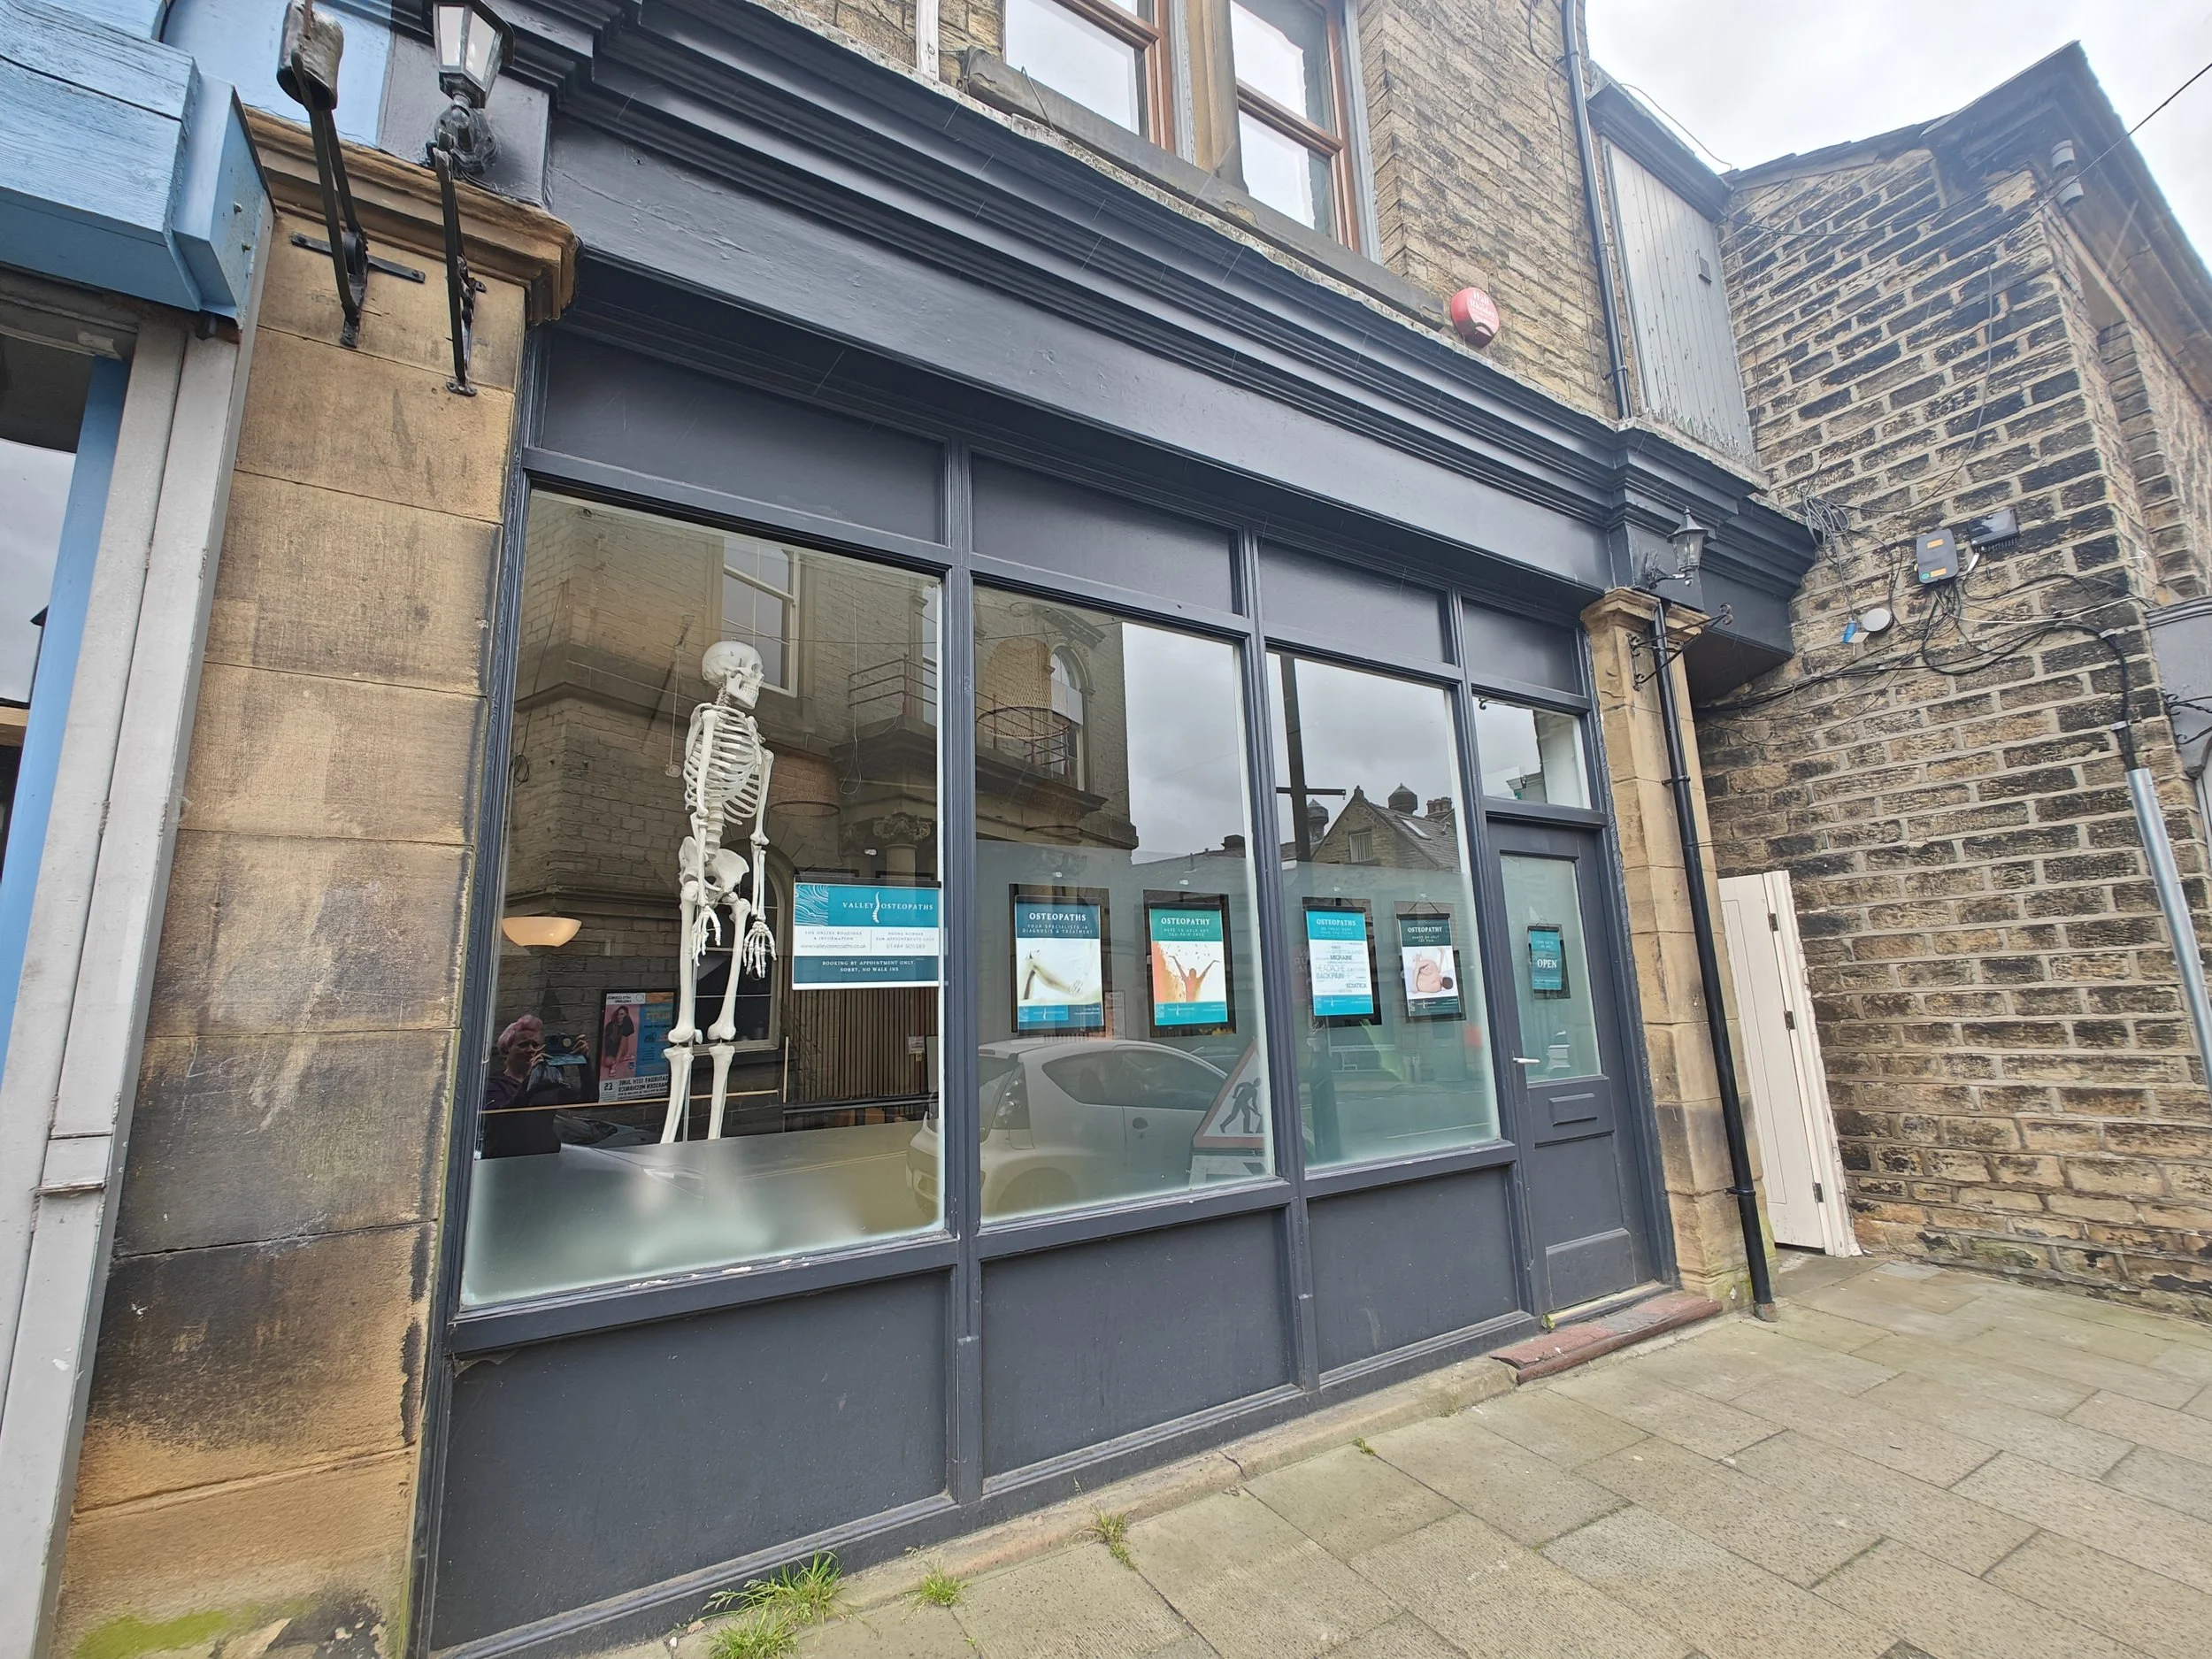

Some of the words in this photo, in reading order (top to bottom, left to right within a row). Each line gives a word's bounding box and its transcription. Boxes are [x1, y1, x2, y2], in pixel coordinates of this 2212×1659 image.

[842, 901, 874, 910] VALLEY
[1029, 912, 1087, 922] OSTEOPATHS
[1160, 917, 1211, 926] OSTEOPATHY
[1537, 958, 1558, 969] OPEN
